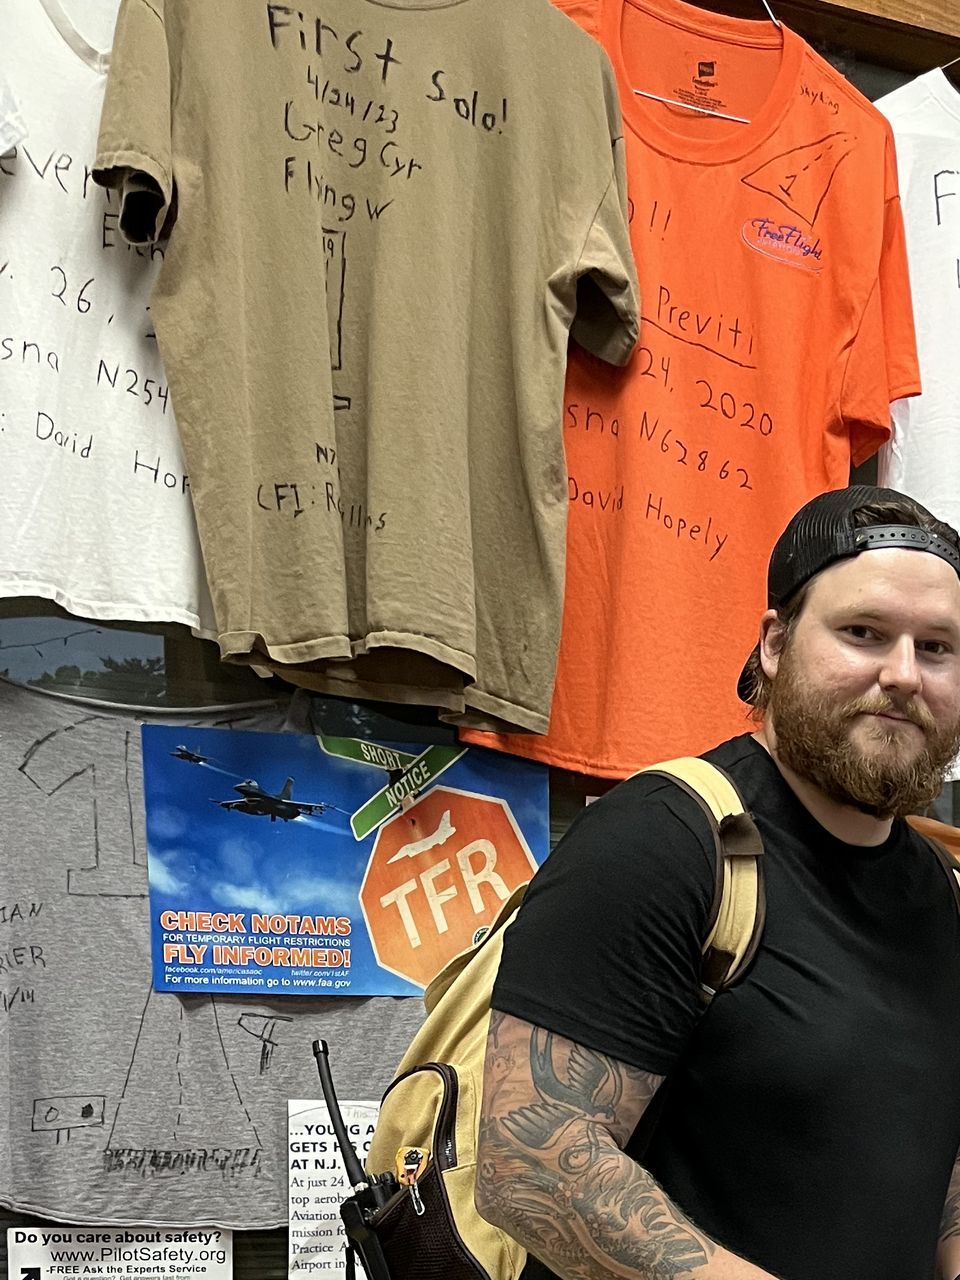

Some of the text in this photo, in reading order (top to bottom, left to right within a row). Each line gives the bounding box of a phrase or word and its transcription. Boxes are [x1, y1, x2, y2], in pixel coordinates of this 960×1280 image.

[267, 4, 507, 135] First Solo!
[307, 65, 399, 134] 4/24/23
[284, 100, 422, 180] Greg Cyr
[657, 285, 754, 355] Previti
[696, 380, 773, 436] 2020
[640, 411, 753, 490] N62862
[646, 493, 728, 561] Hopely
[360, 743, 401, 768] SHORT
[385, 760, 431, 807] NOTICE
[379, 838, 511, 950] TFR
[160, 910, 352, 936] CHECK NOTAMS
[162, 933, 351, 947] FOR TEMPORARY FLIGHT RESTRICTIONS
[163, 943, 351, 968] FLY INFORMED!
[165, 974, 351, 989] For more information go to www.faa.gov
[290, 1141, 328, 1153] GETS
[290, 1158, 342, 1170] AT N.J.
[290, 1176, 304, 1188] At
[306, 1177, 327, 1190] just
[291, 1194, 310, 1208] top
[291, 1210, 337, 1222] Aviation
[15, 1230, 222, 1246] Do you care about safety?
[291, 1226, 333, 1238] mission
[50, 1247, 226, 1264] www.PilotSafety.org
[291, 1242, 334, 1255] Practice
[82, 1265, 104, 1274] Ask
[106, 1265, 123, 1274] the
[126, 1264, 166, 1275] Experts
[169, 1264, 207, 1273] Service
[291, 1259, 345, 1274] Airport in
